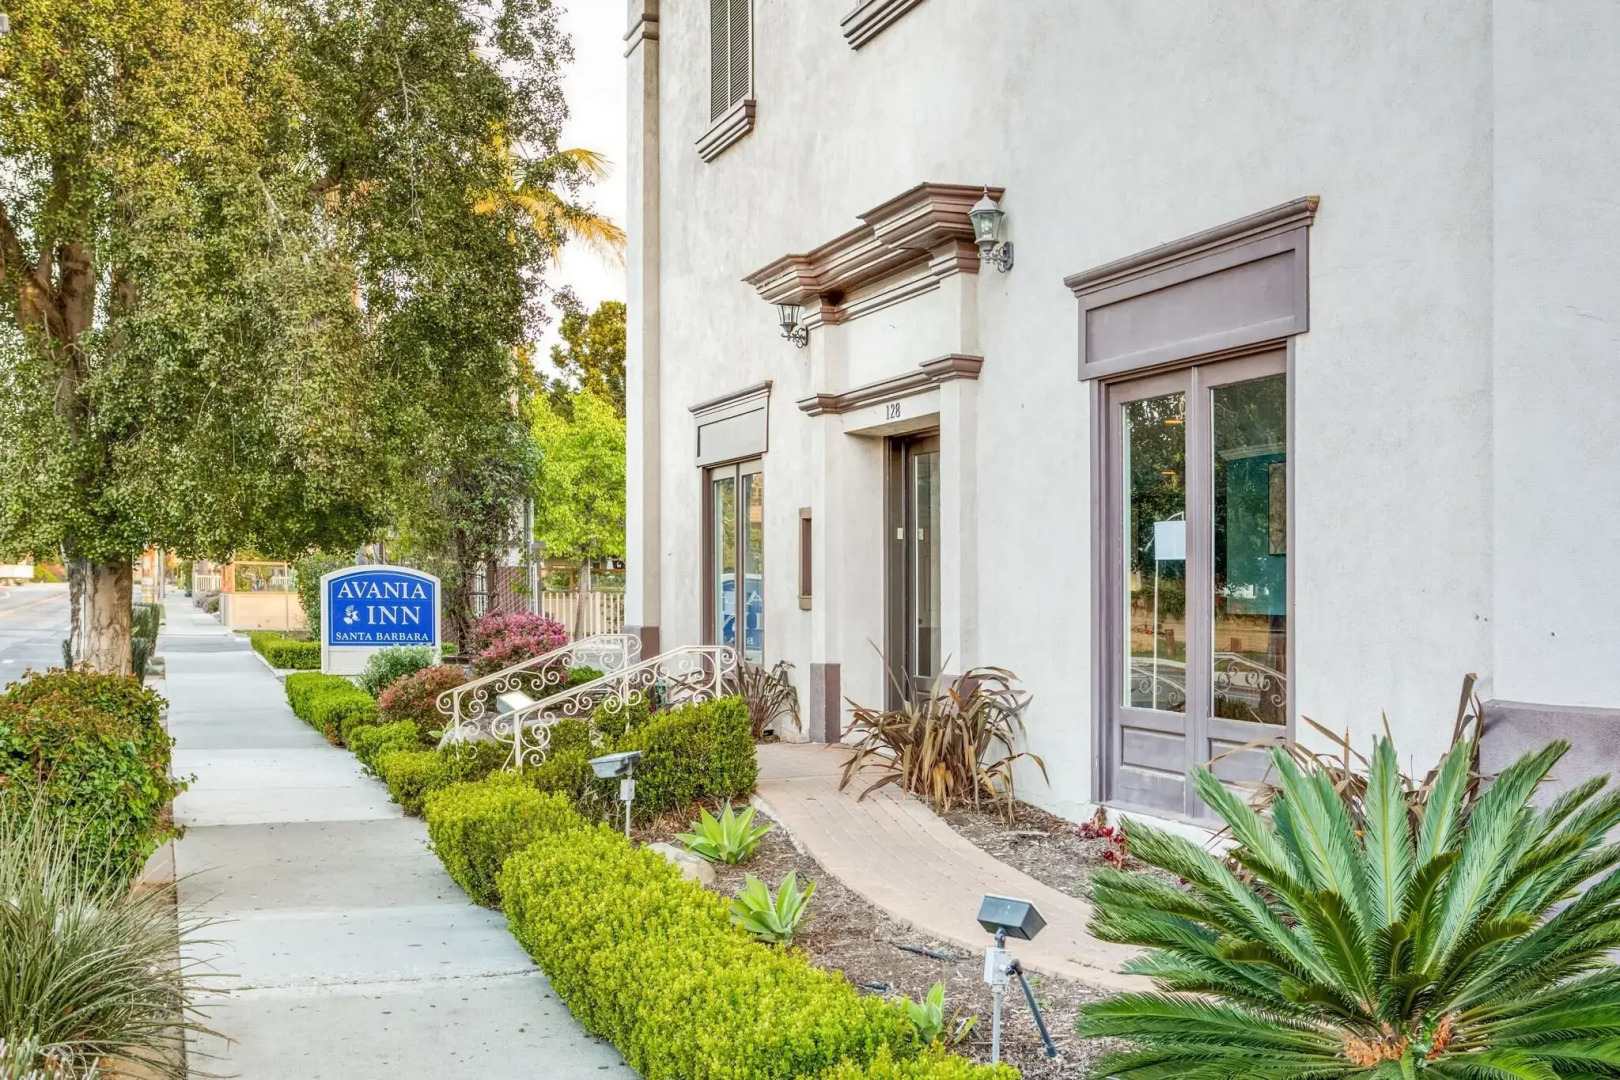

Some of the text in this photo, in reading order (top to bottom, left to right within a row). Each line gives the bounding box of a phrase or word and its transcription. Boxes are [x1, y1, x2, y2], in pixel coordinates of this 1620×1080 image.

[886, 402, 901, 420] 128
[337, 581, 428, 599] AVANIA
[366, 605, 421, 625] INN
[335, 631, 429, 641] SANTA BARBARA
